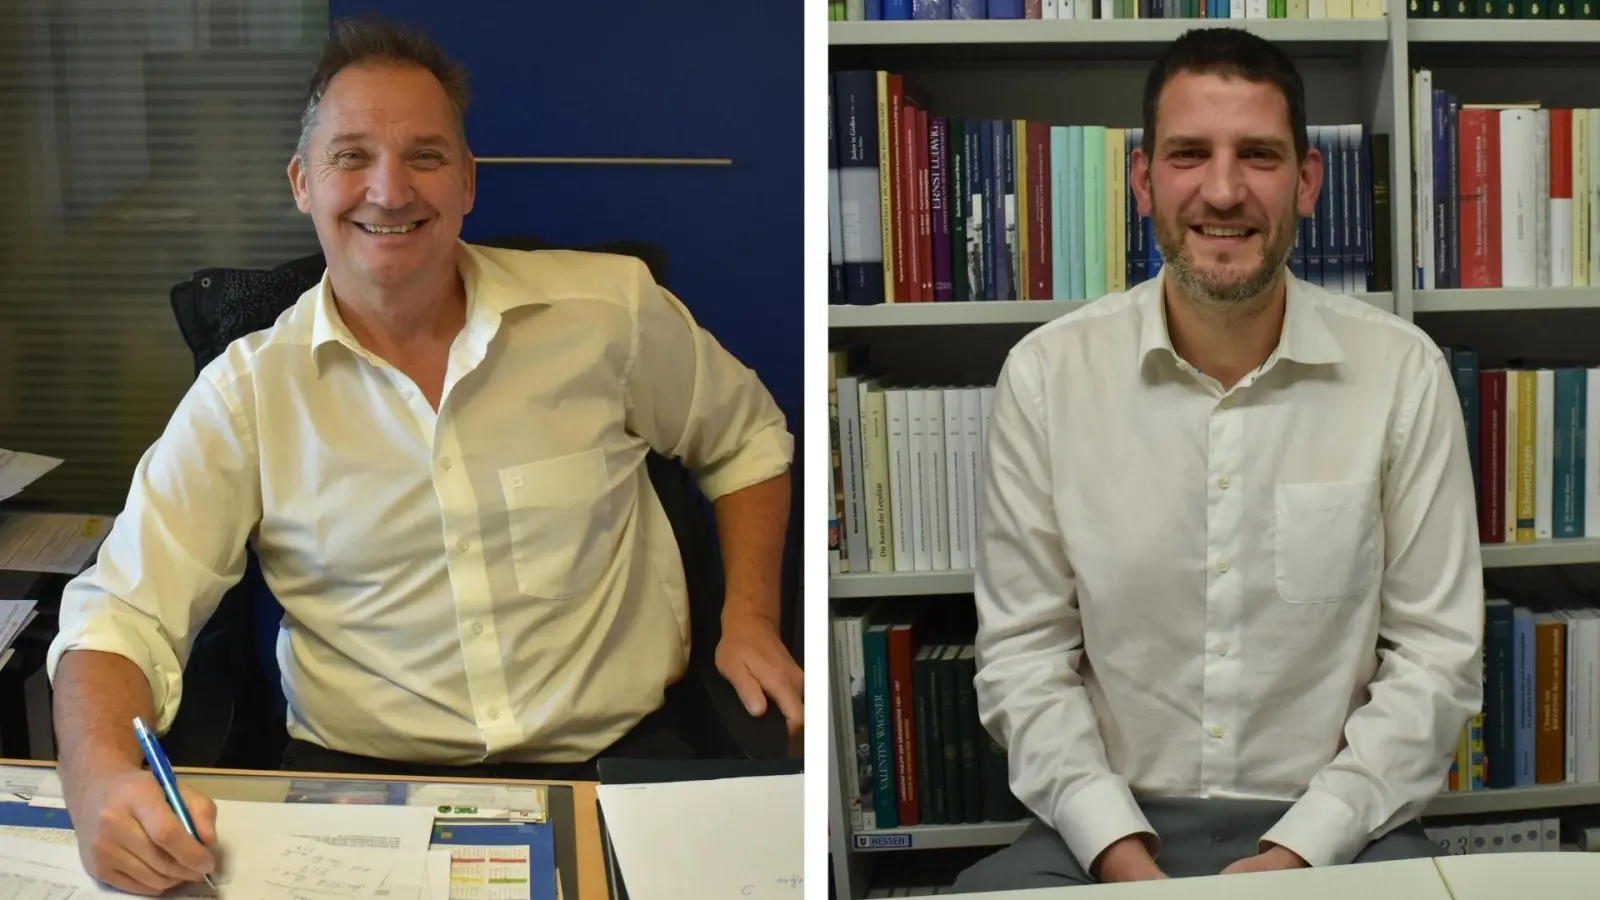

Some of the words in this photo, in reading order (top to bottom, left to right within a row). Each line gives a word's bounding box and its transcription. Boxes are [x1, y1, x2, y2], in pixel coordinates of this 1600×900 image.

[850, 144, 858, 160] Juden
[930, 126, 940, 170] LUDWIG
[932, 171, 941, 209] ERNST
[876, 483, 884, 512] Loyalität
[1522, 446, 1534, 516] Schwetzingen
[878, 526, 886, 544] Kunst
[874, 694, 886, 738] WAGNER
[876, 742, 888, 790] VALENTIN
[872, 837, 904, 845] HESSEN
